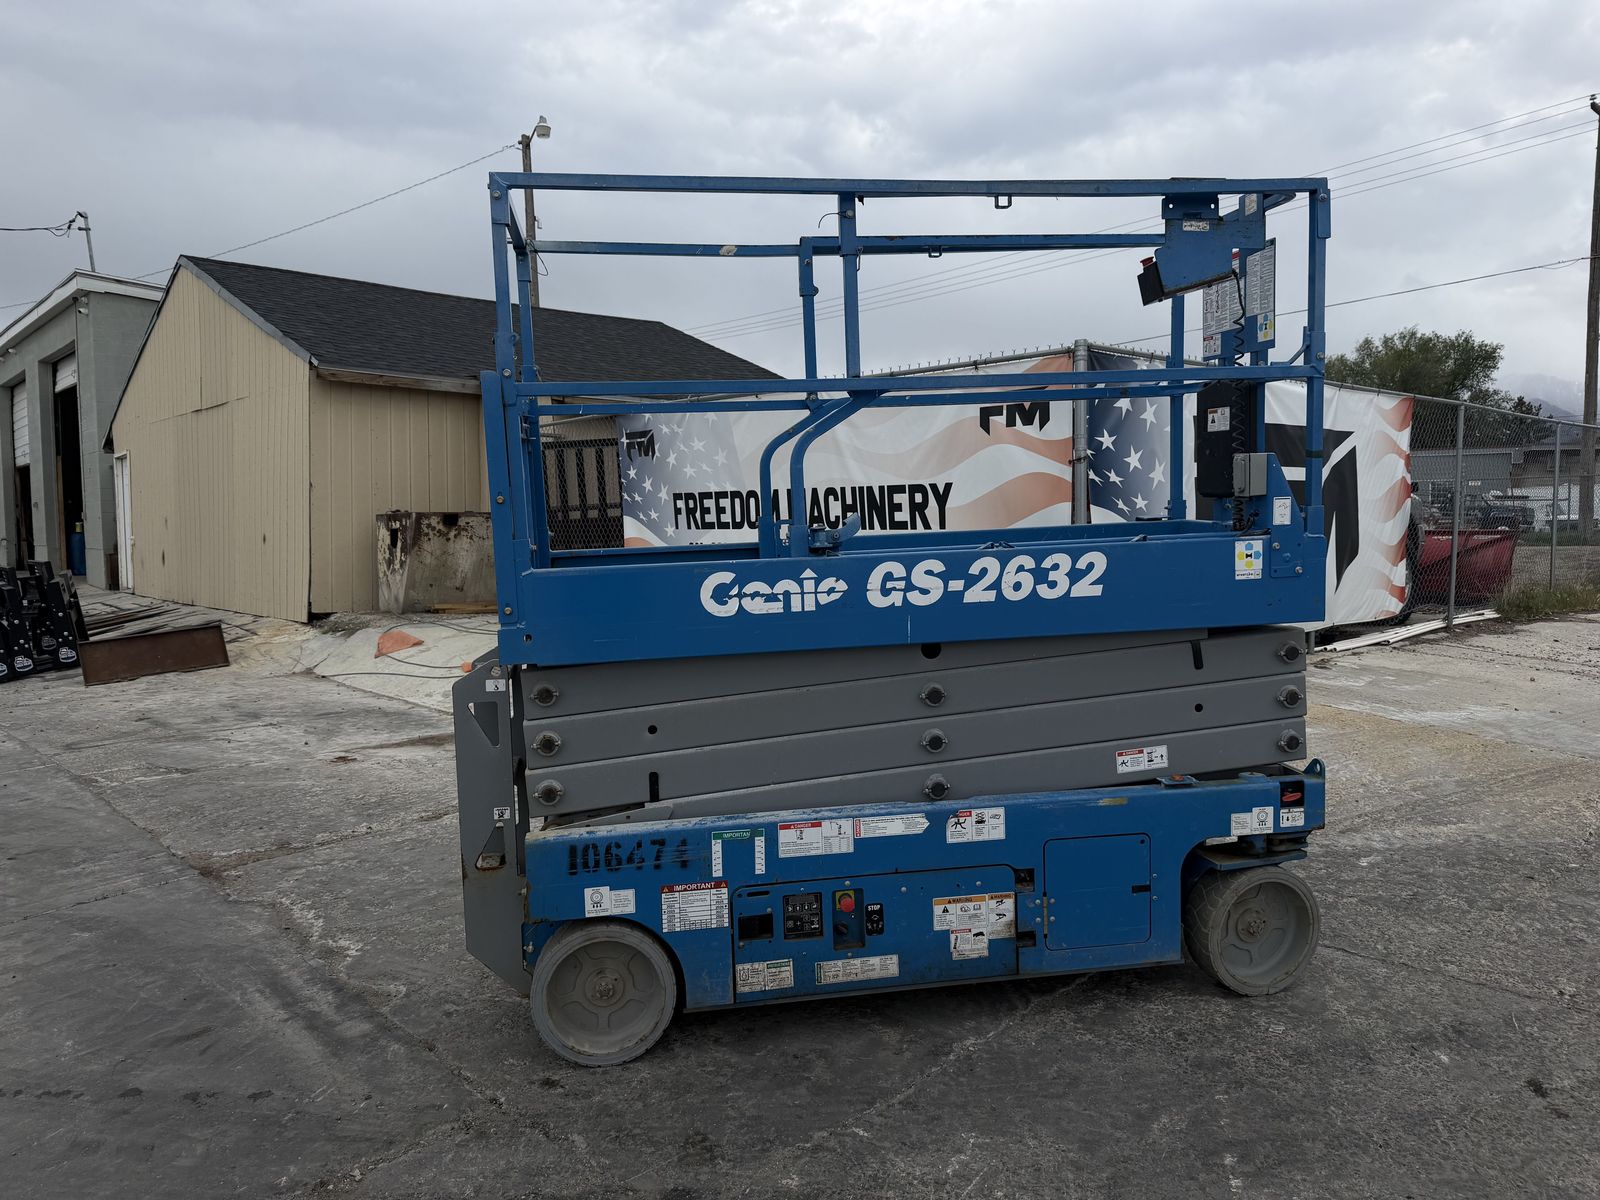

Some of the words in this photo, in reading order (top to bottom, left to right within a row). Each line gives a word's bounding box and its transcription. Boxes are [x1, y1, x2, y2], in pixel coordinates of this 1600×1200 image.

[700, 567, 848, 618] Genie
[866, 551, 1108, 608] GS-2632
[673, 882, 716, 892] IMPORTANT
[867, 904, 881, 912] STOP
